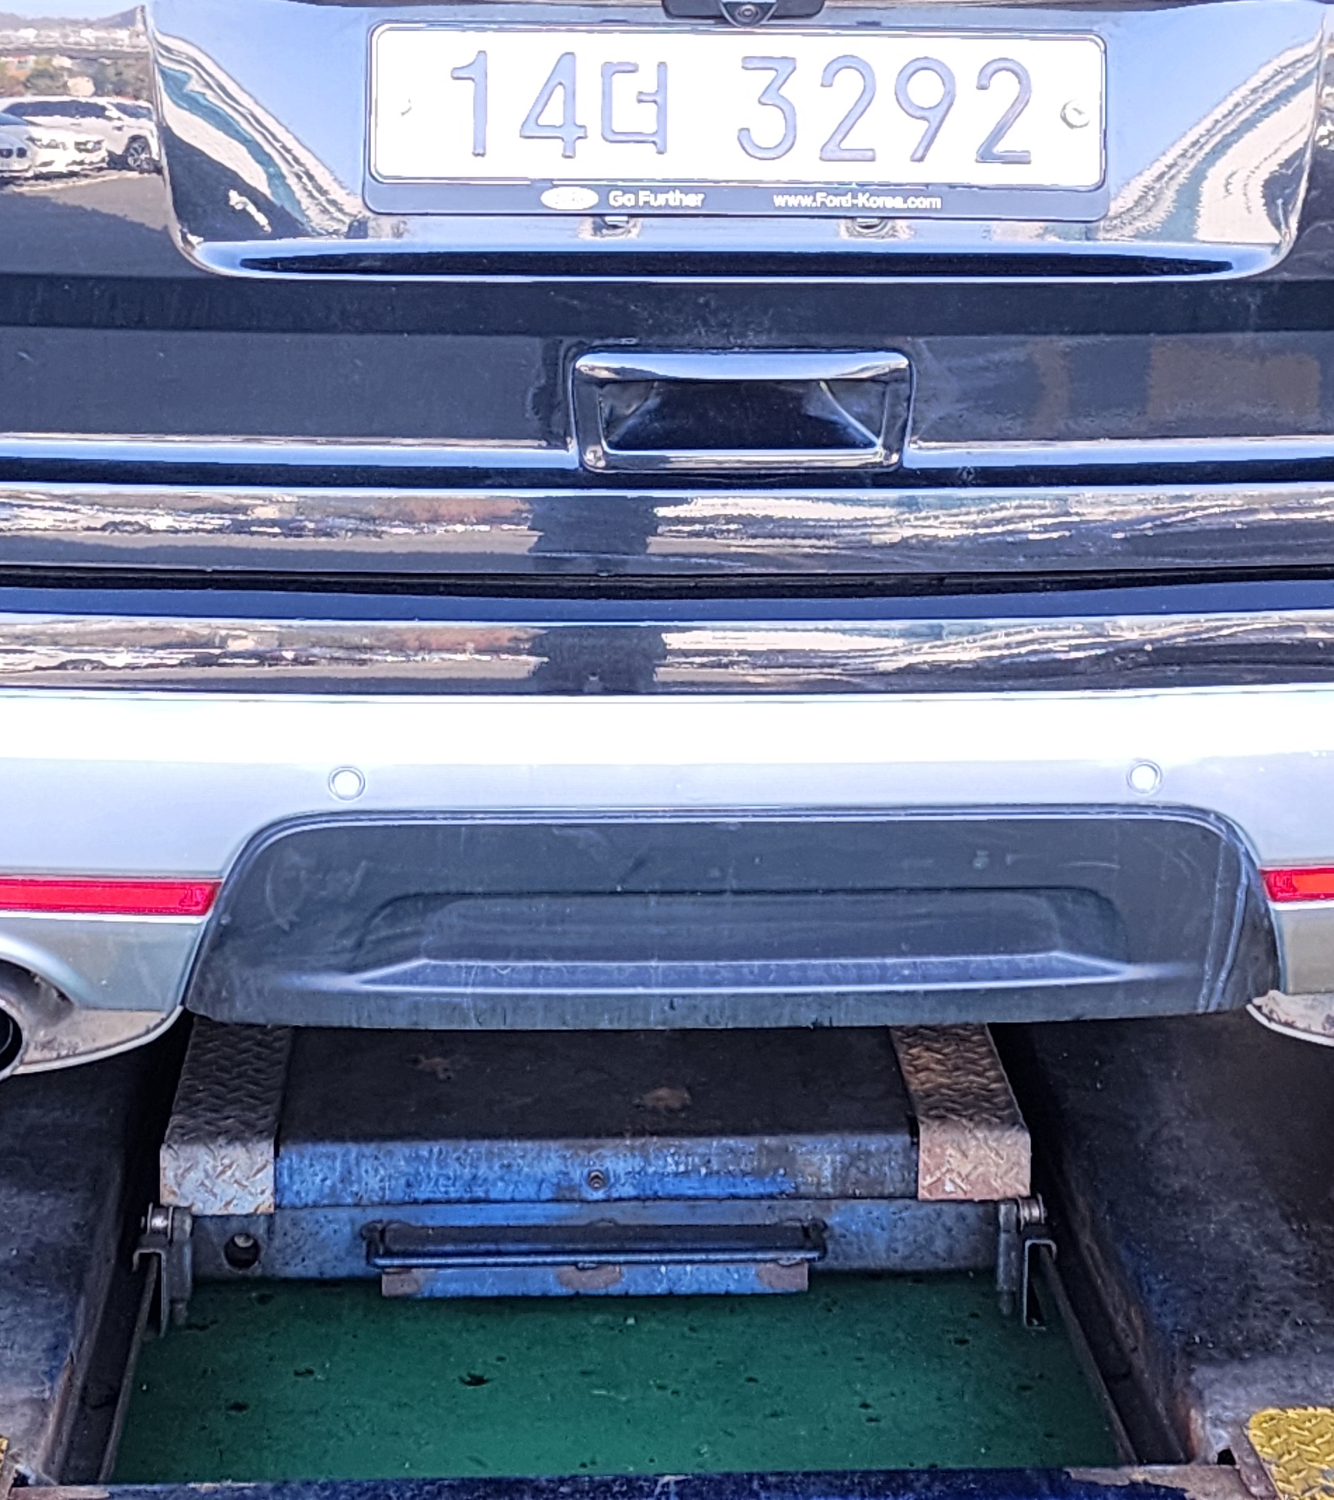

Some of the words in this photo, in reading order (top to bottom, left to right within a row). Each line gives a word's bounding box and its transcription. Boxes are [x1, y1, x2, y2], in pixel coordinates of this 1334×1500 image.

[451, 49, 668, 159] 14더
[737, 54, 1033, 165] 3292
[608, 189, 635, 207] Go
[638, 188, 705, 208] Further
[773, 191, 942, 209] www.Ford-Korea.com
